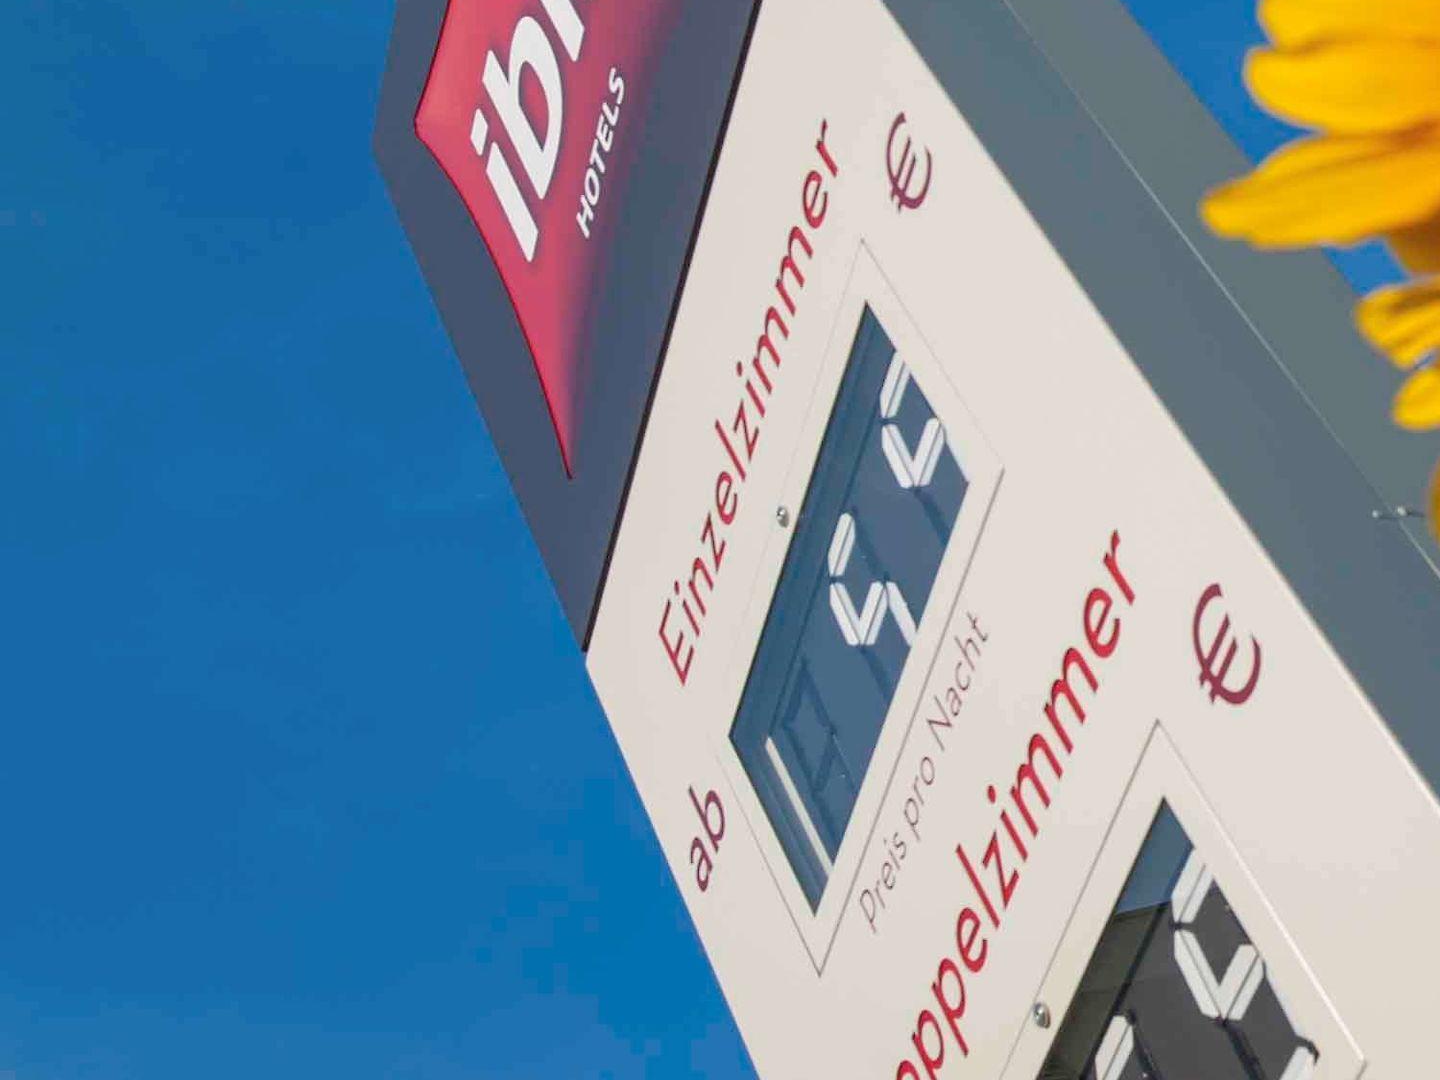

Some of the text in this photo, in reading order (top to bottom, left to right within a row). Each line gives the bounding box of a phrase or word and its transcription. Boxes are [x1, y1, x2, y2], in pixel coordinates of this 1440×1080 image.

[576, 66, 625, 238] HOTELS
[658, 118, 839, 687] Einzelzimmer
[687, 784, 726, 892] ab
[885, 111, 933, 213] €
[858, 610, 989, 935] Preis pro Nacht
[1191, 582, 1262, 706] €
